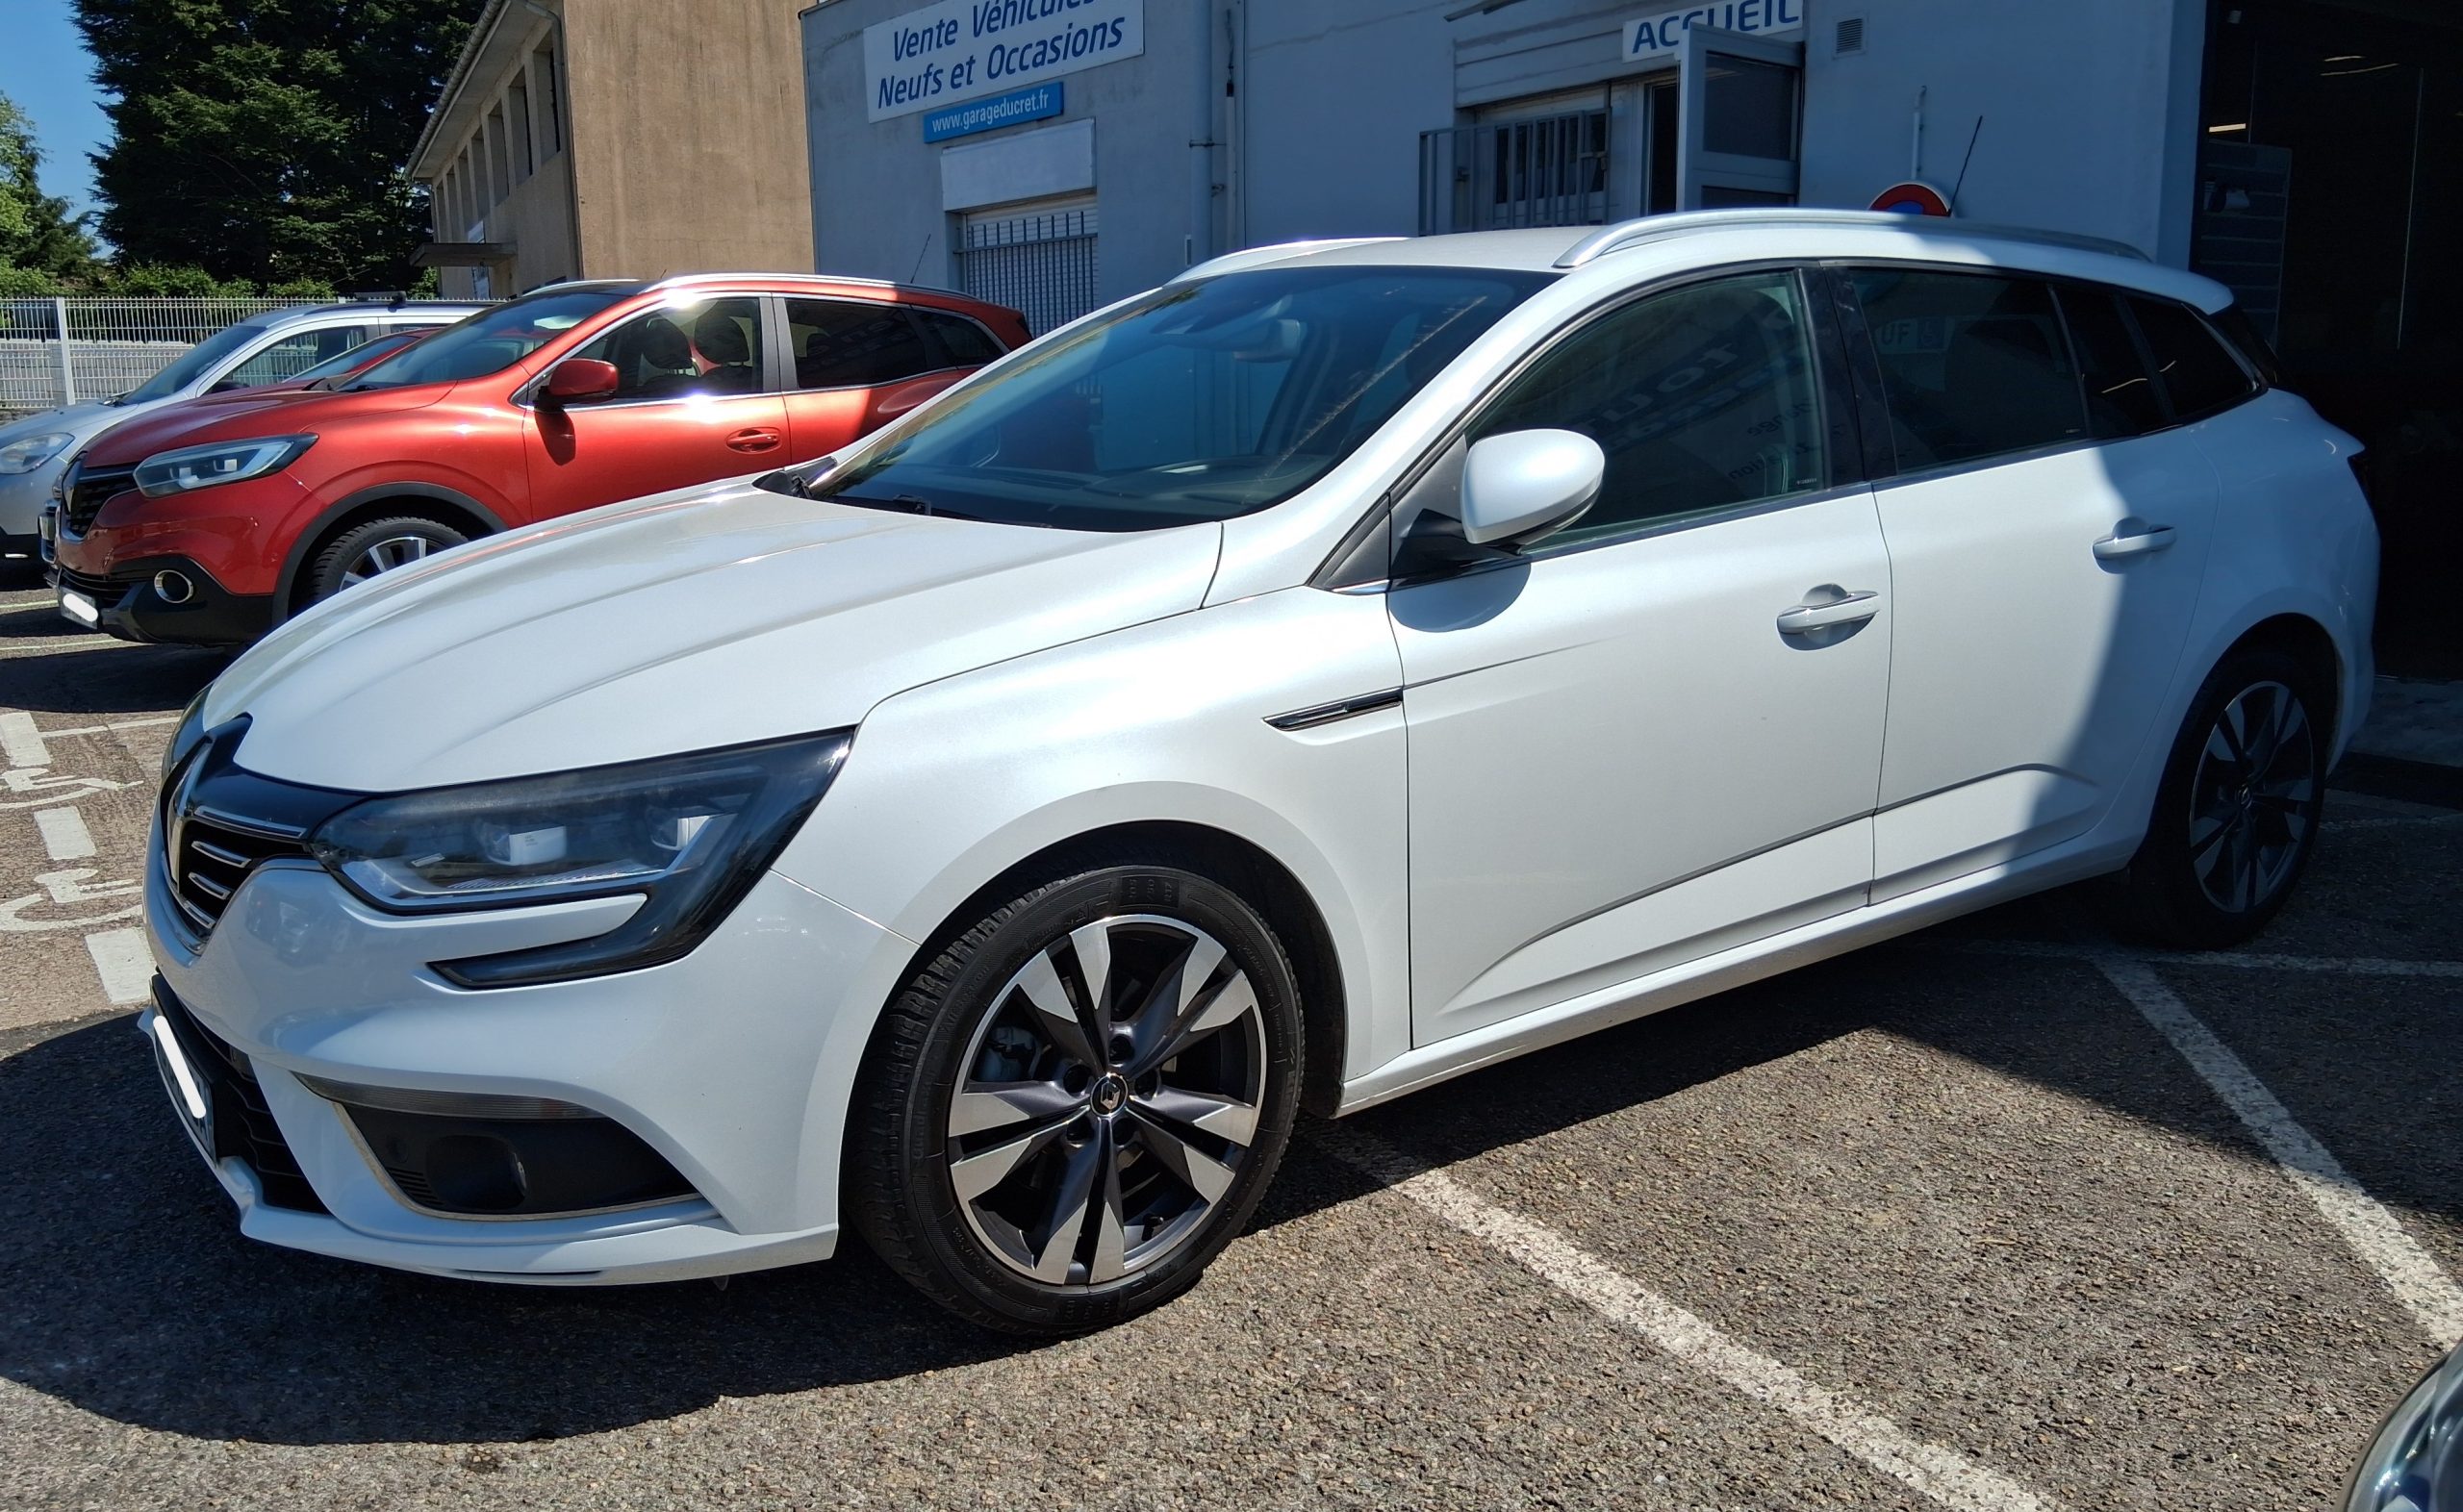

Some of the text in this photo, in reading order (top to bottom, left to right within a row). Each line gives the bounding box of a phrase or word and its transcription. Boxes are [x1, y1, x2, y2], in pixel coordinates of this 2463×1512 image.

[894, 0, 1095, 62] Vente Véhicu
[877, 16, 1126, 109] Neufs et Occasions
[932, 89, 1049, 131] www.garageducret.fr
